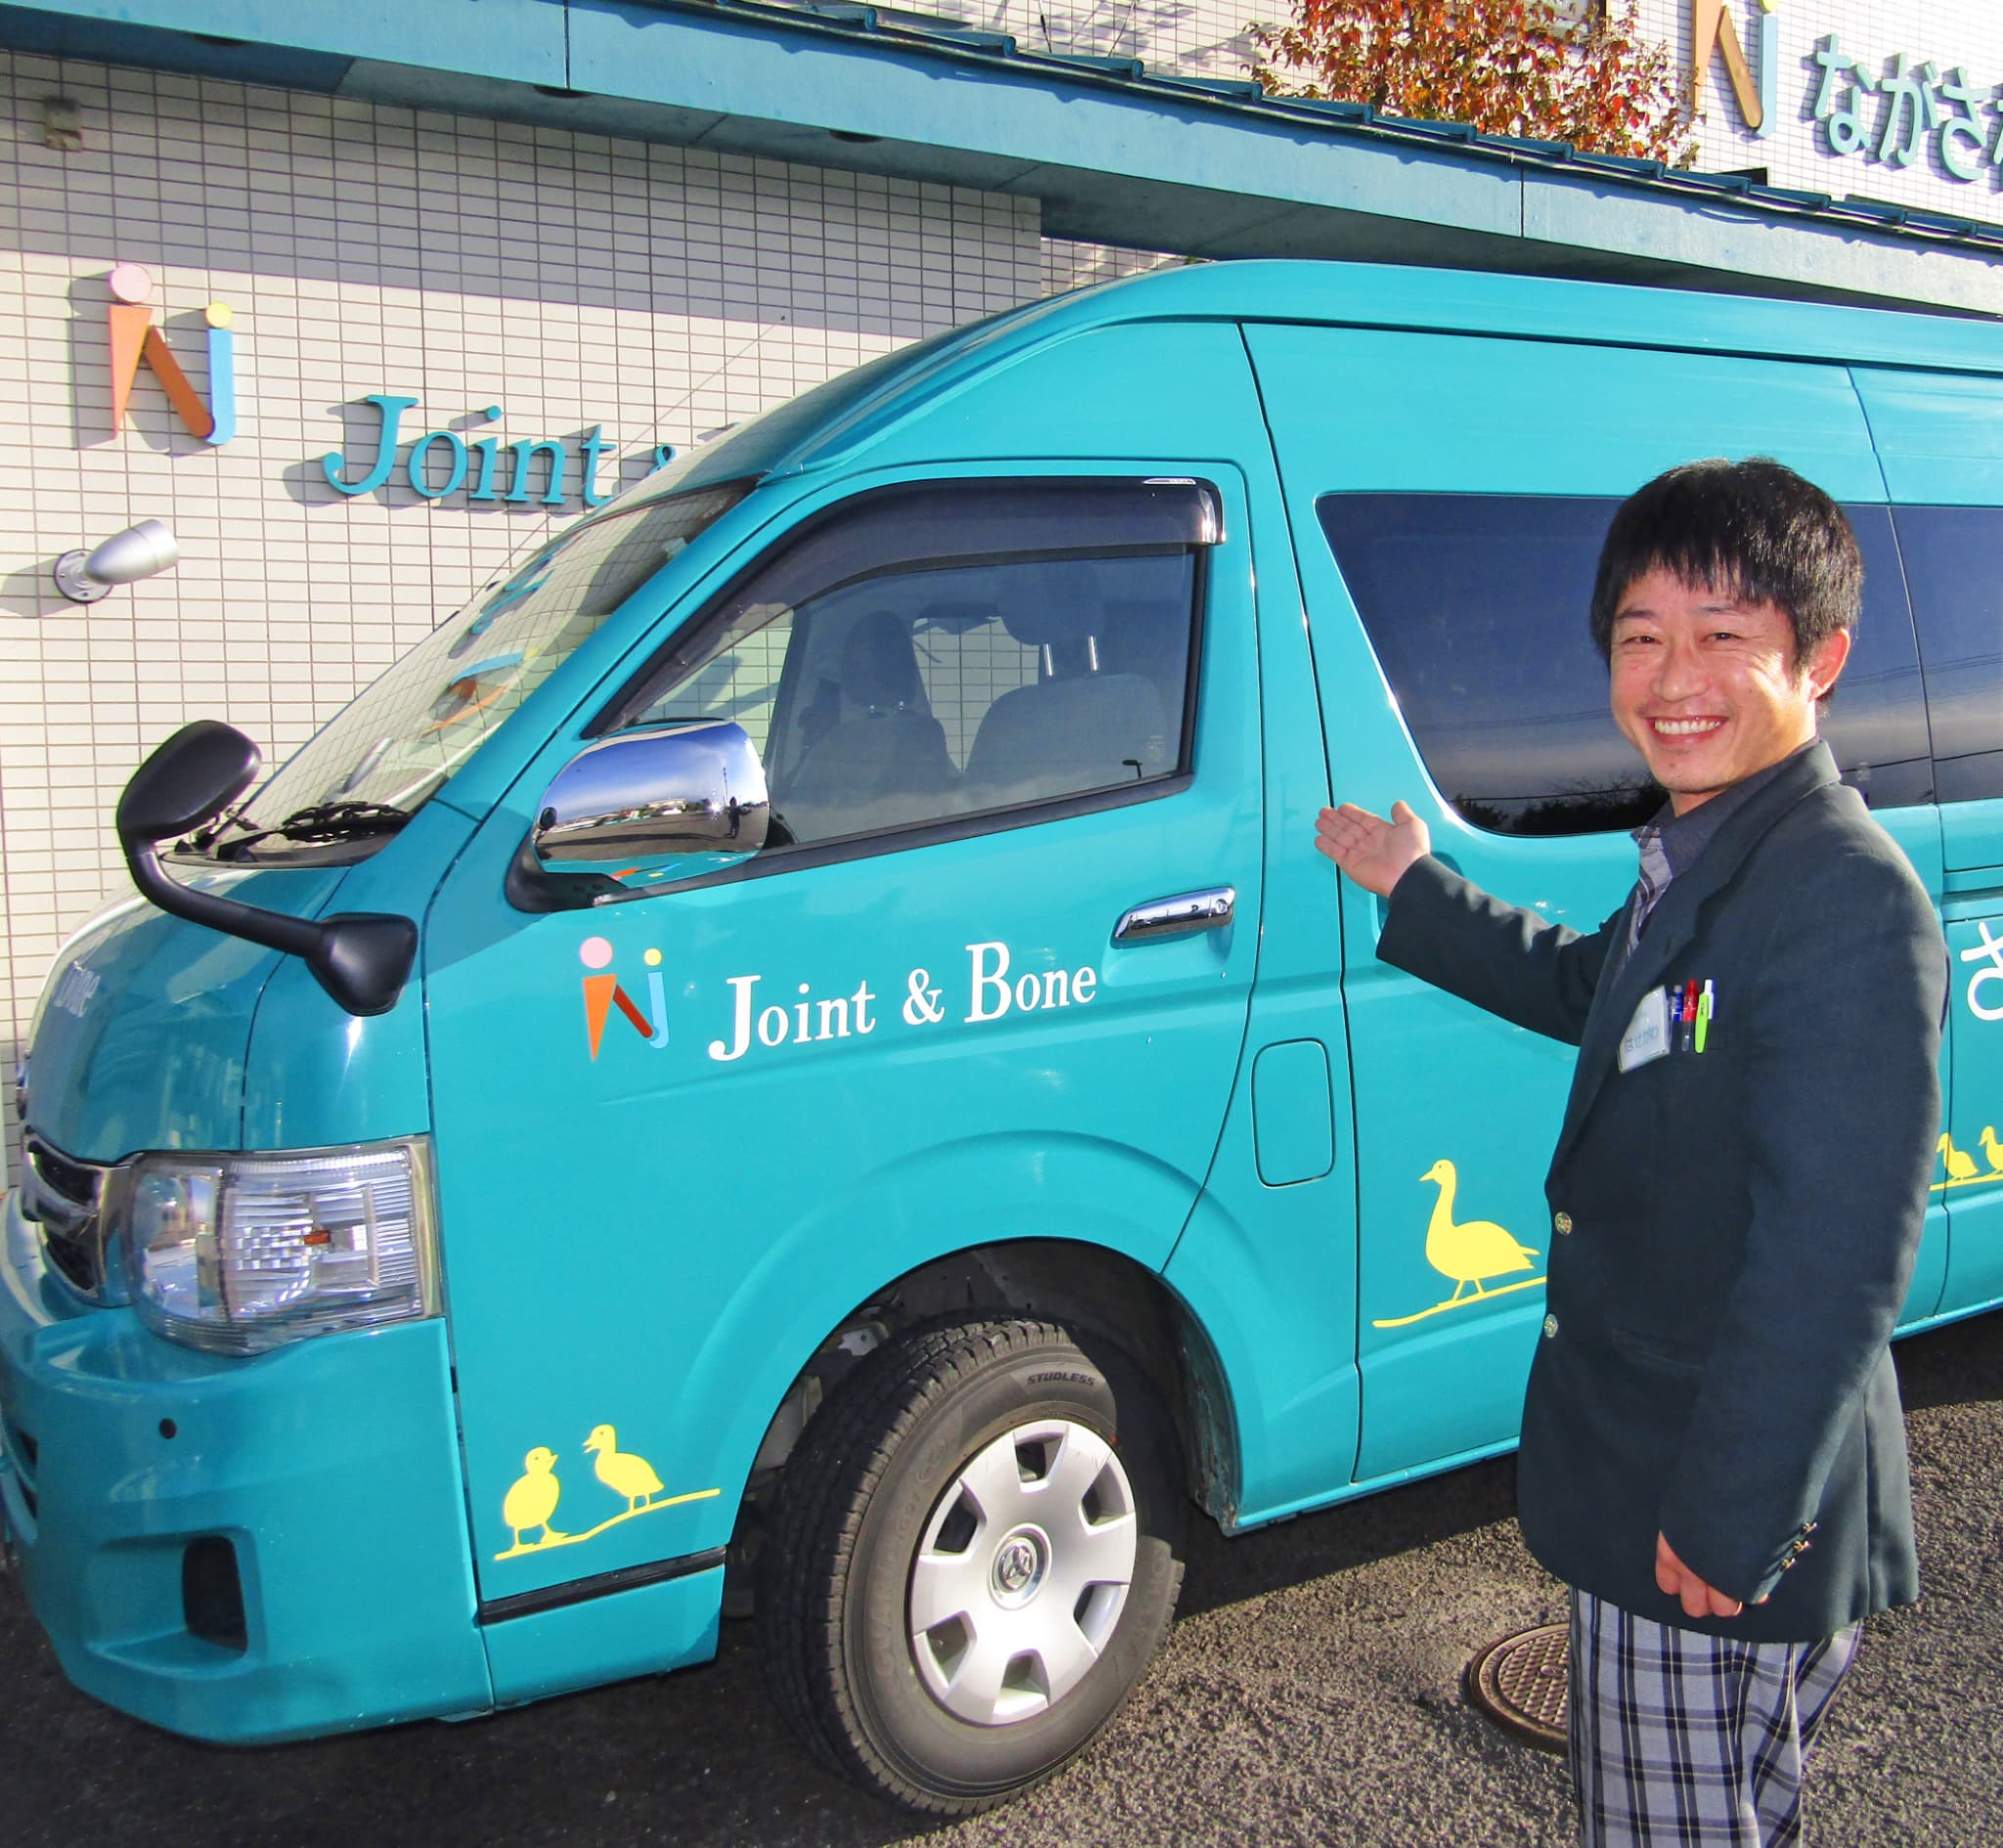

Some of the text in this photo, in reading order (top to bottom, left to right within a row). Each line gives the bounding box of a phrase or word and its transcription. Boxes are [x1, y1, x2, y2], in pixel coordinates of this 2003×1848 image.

[1814, 32, 2003, 182] ながさ
[322, 393, 617, 507] Joint
[708, 941, 1097, 1062] Joint & Bone
[1026, 1371, 1096, 1387] STUDLESS
